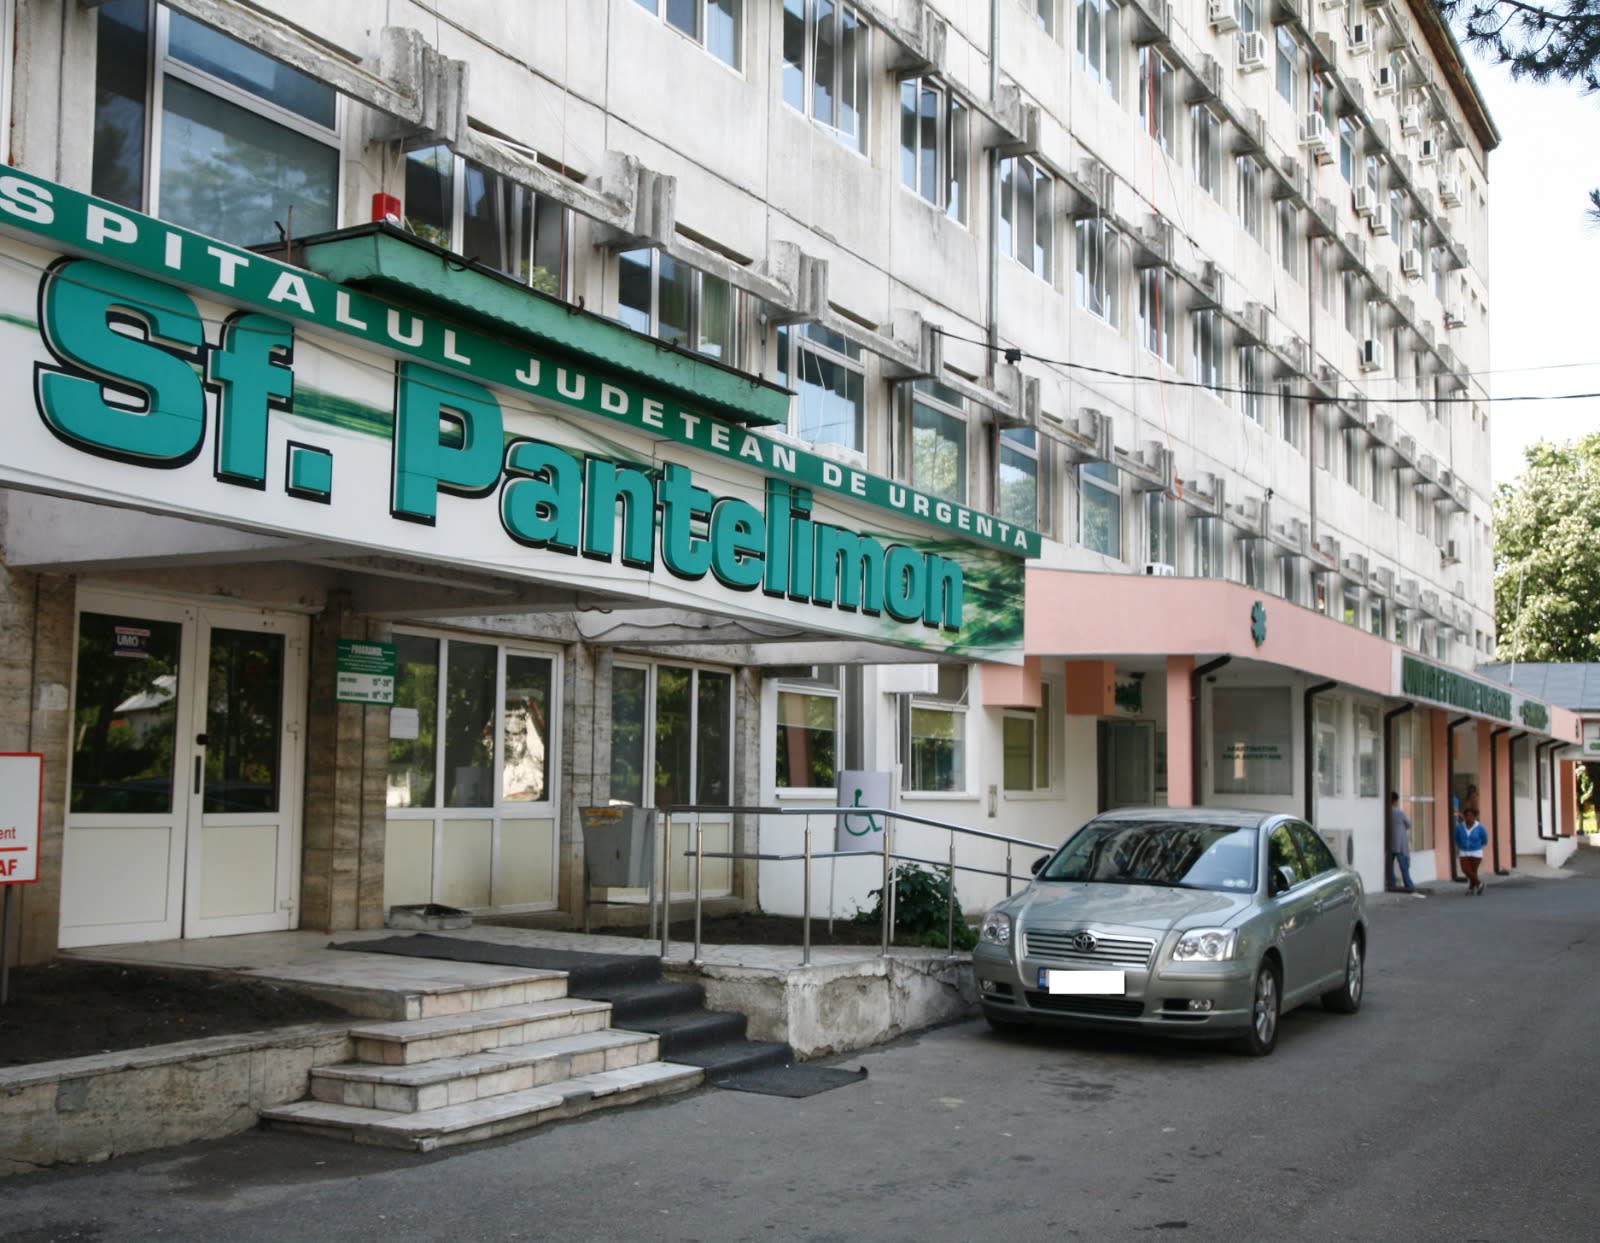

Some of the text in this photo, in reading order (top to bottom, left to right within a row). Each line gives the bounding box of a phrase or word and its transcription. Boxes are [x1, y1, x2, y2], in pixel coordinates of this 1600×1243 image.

[0, 175, 1028, 550] SPITALUL JUDETEAN DE URGENTA
[33, 256, 963, 632] Sf. Pantelimon
